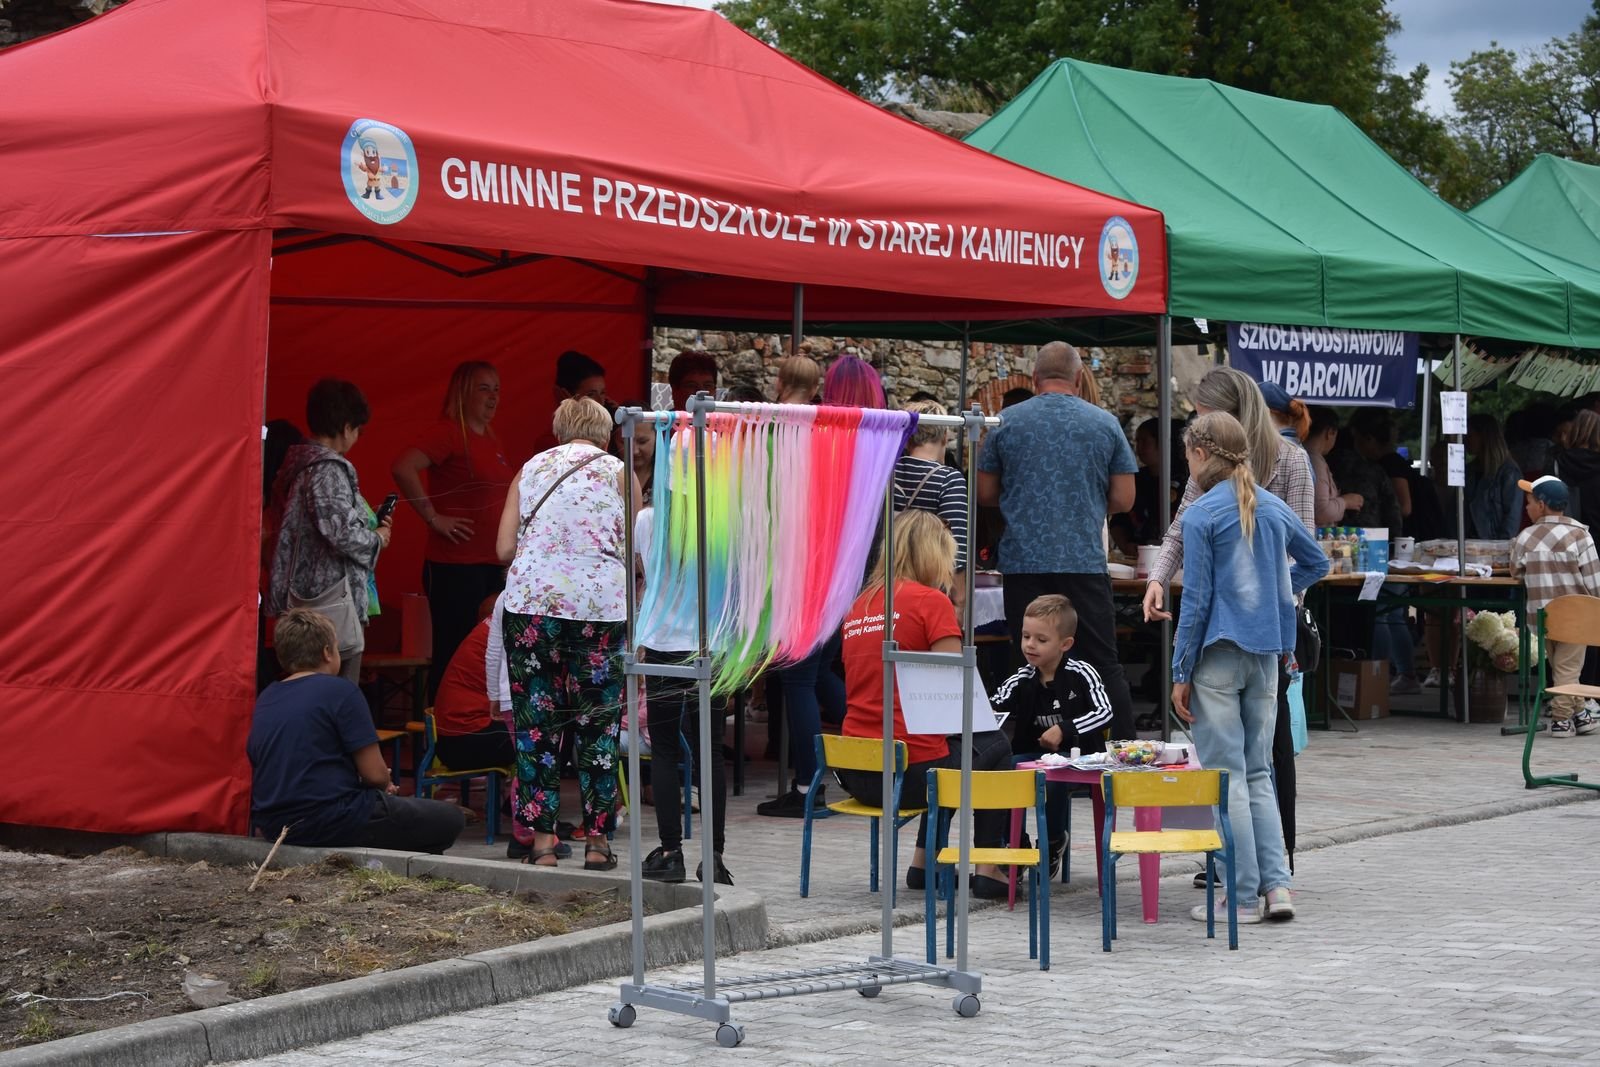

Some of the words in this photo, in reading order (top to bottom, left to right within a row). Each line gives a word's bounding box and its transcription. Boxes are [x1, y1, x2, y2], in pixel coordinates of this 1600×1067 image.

[441, 157, 583, 213] GMINNE
[593, 177, 816, 243] PRZEDSZKOLE
[856, 218, 954, 258] STAREJ
[961, 225, 1085, 269] KAMIENICY
[1238, 323, 1299, 352] SZKOŁA
[1302, 326, 1404, 356] PODSTAWOWA
[1262, 360, 1283, 385] W
[1285, 361, 1382, 398] BARCINKU
[863, 611, 900, 624] Przedszle
